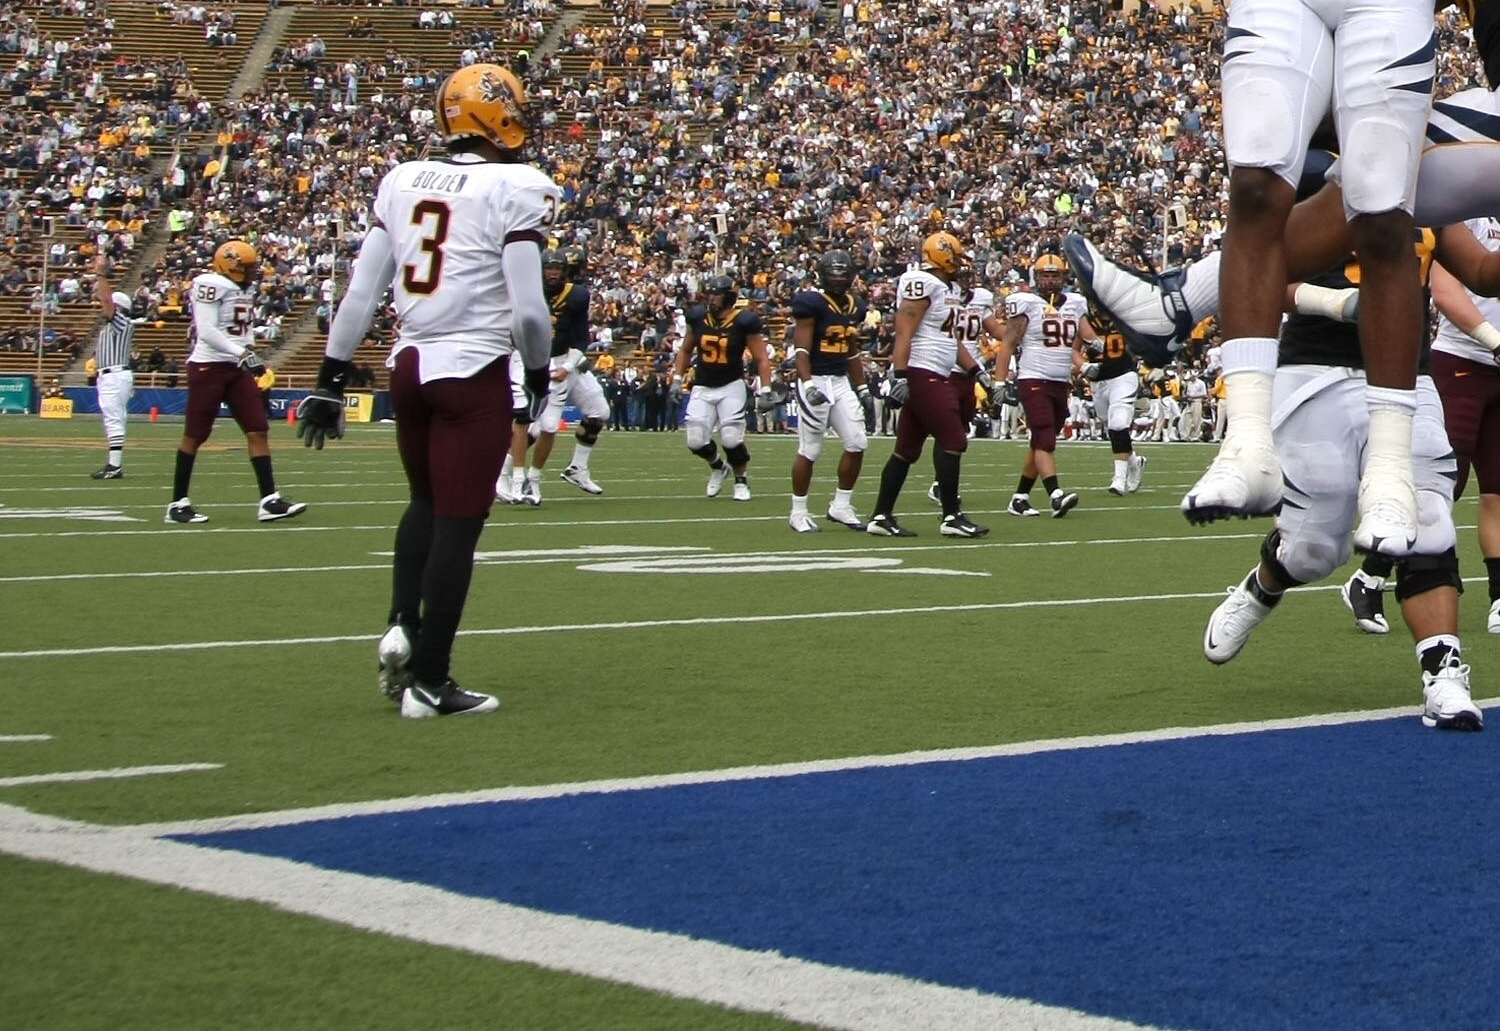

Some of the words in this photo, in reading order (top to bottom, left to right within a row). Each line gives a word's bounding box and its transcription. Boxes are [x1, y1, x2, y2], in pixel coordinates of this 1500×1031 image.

[412, 170, 469, 193] BOLDEN
[403, 199, 451, 296] 3
[197, 284, 217, 301] 58
[904, 281, 925, 297] 49
[1042, 319, 1077, 348] 90
[701, 334, 728, 364] 51
[41, 404, 70, 413] BEARS
